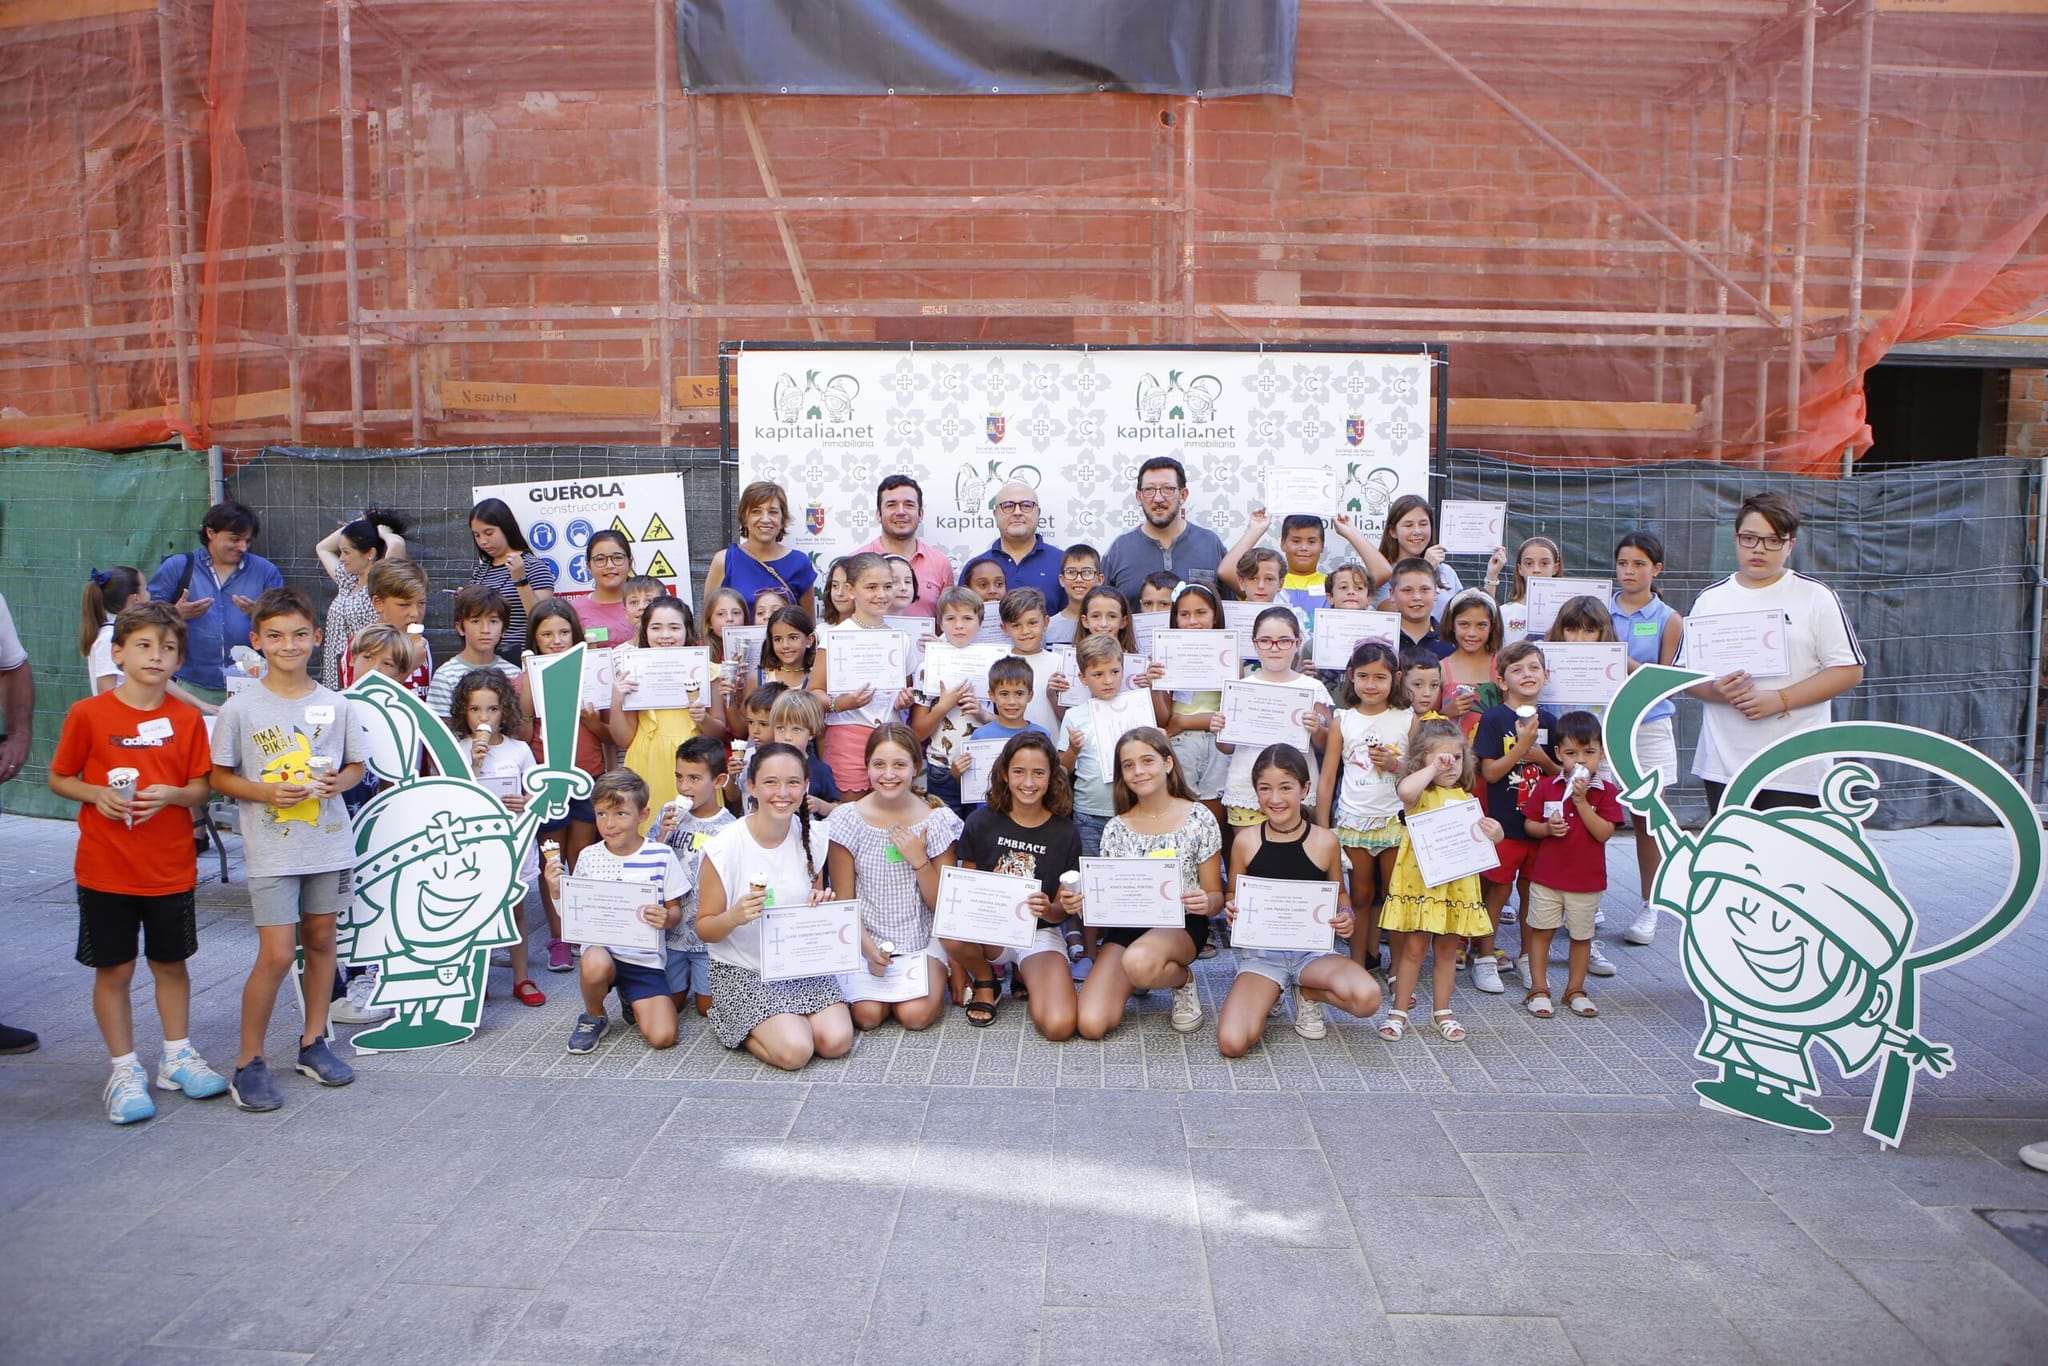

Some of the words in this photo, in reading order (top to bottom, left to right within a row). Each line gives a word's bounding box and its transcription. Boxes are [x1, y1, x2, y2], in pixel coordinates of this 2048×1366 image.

[755, 423, 874, 443] kapitalia.net
[1117, 422, 1235, 443] kapitalia.net
[822, 439, 874, 448] inmobiliaria
[1184, 439, 1236, 448] inmobiliaria
[529, 482, 624, 502] GUEROLA
[997, 836, 1048, 855] EMBRACE
